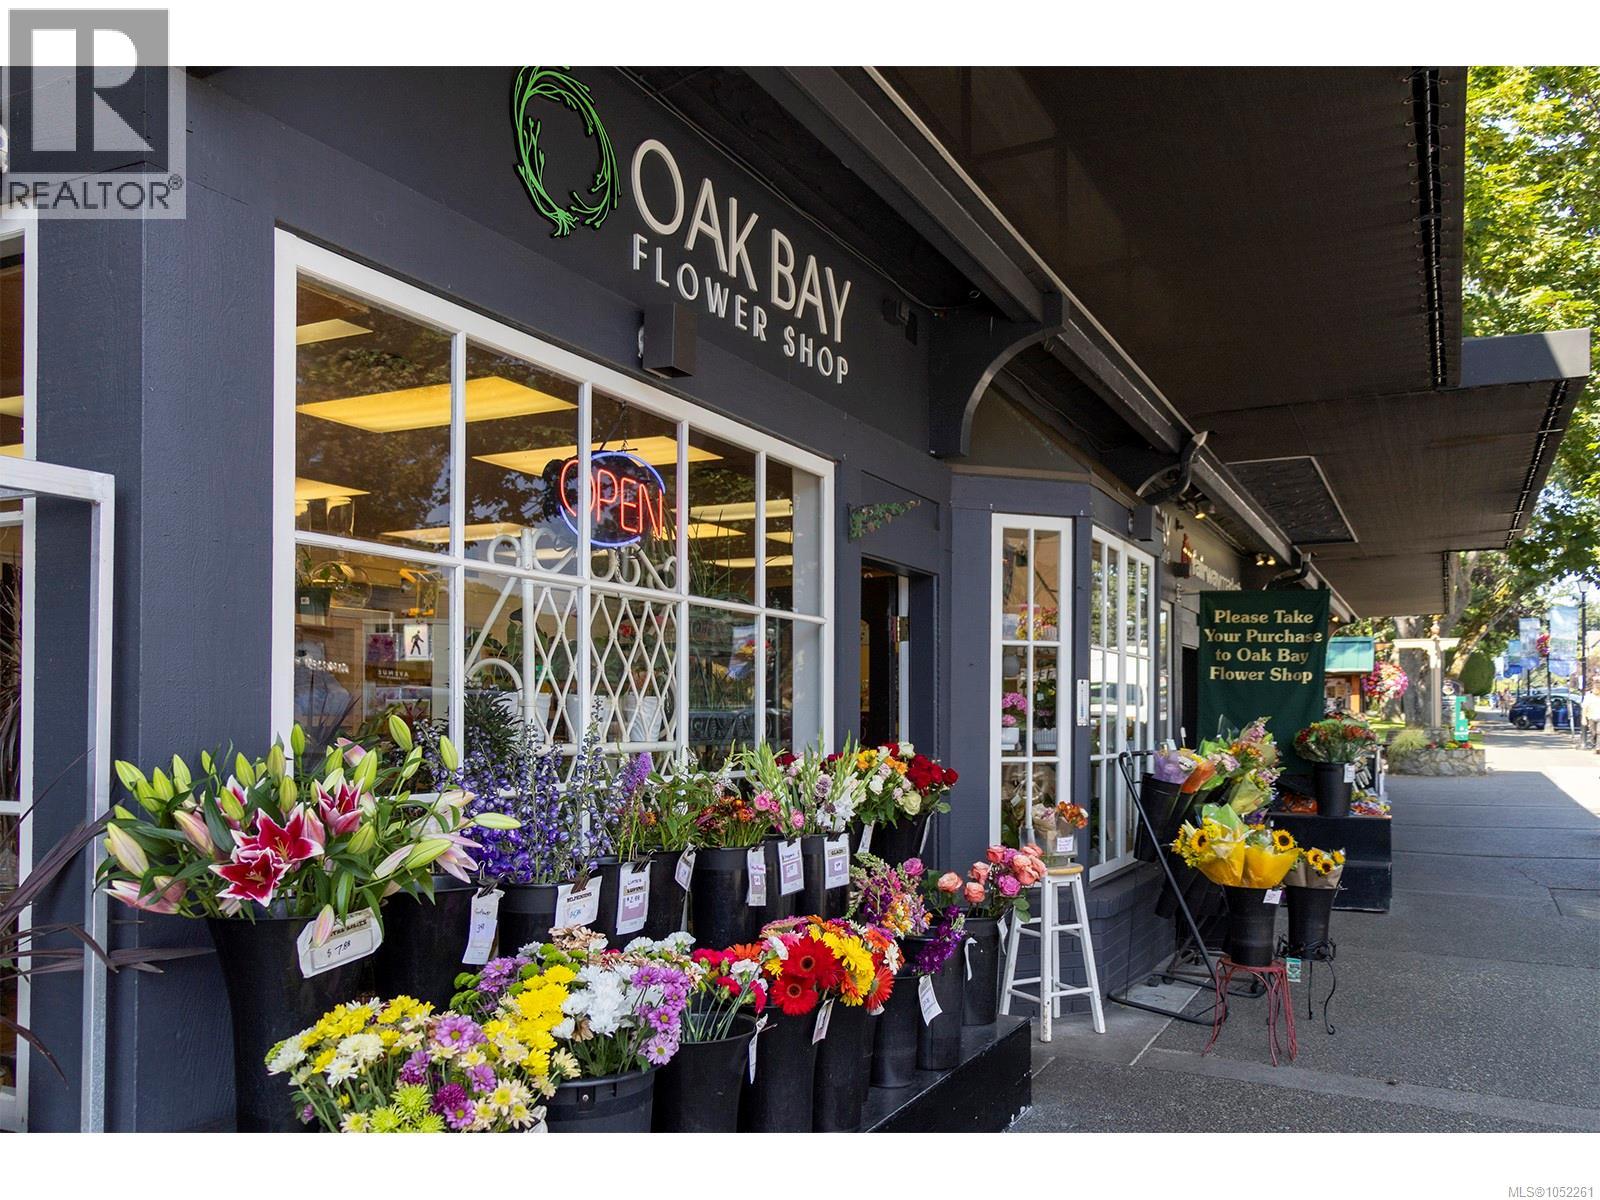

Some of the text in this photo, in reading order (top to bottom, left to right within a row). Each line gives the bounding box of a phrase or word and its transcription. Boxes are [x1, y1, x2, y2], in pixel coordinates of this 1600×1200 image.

[631, 139, 851, 343] OAK BAY
[632, 233, 849, 384] FLOWER SHOP
[561, 459, 663, 540] OPEN
[1214, 609, 1314, 624] Please Take
[1204, 628, 1323, 643] Your Purchase
[1215, 647, 1309, 665] to Oak Bay
[1209, 666, 1313, 684] Flower Shop
